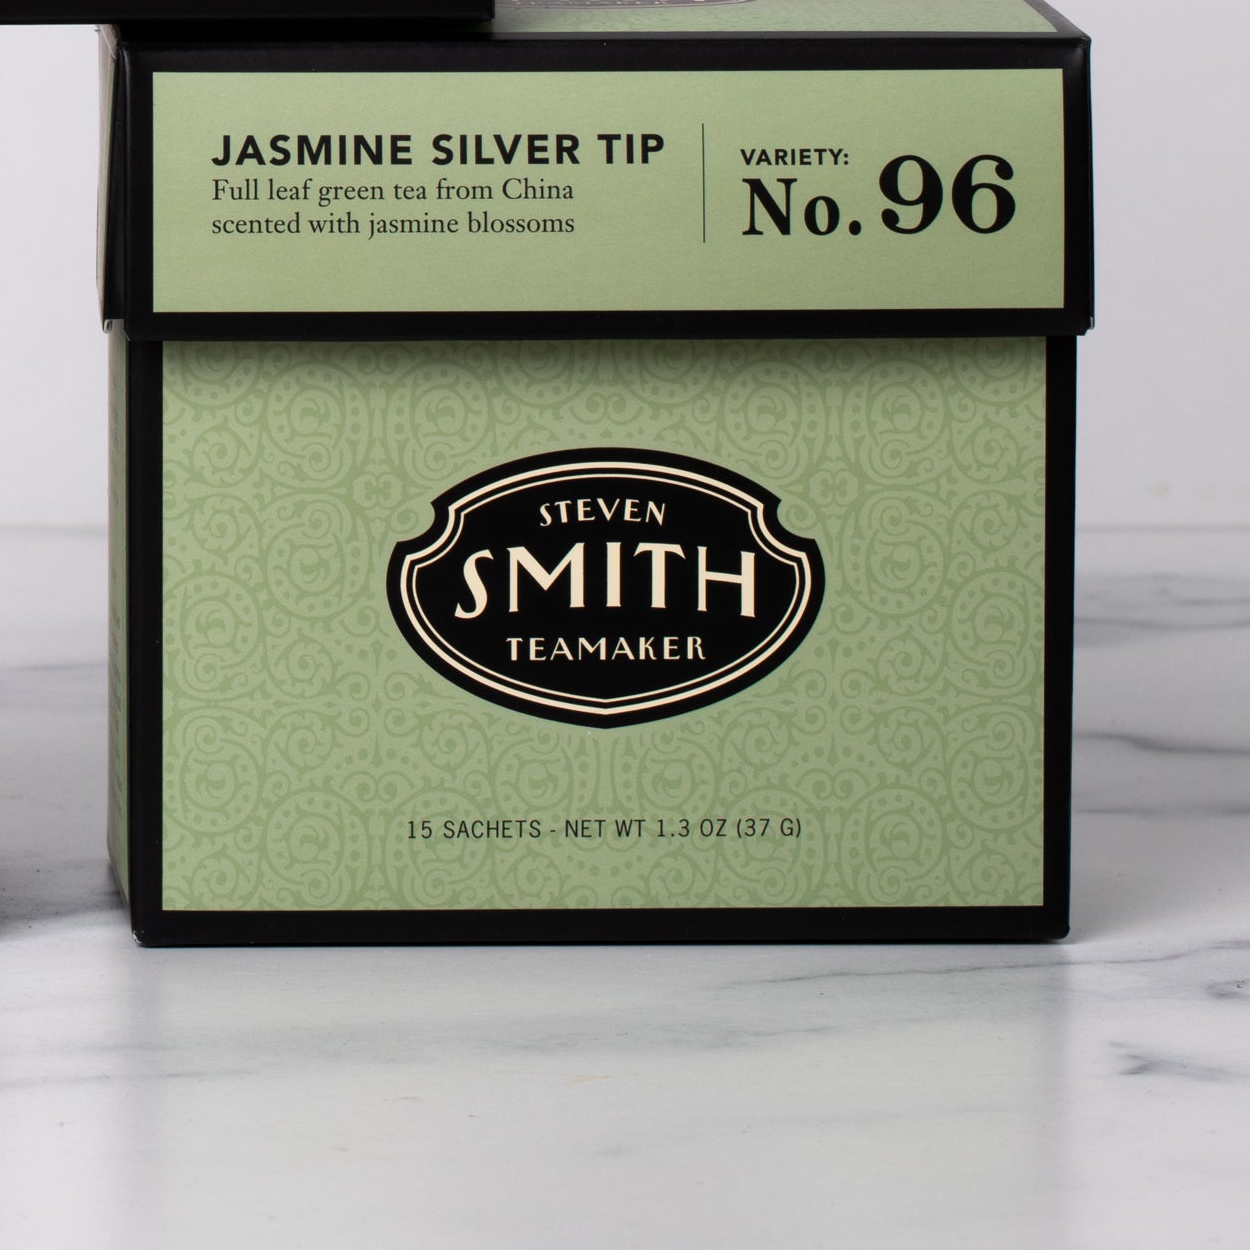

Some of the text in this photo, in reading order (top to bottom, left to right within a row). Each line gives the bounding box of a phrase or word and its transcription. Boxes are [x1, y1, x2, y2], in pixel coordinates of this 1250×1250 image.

[211, 133, 665, 167] JASMINE SILVER TIP
[740, 148, 849, 166] VARIETY:
[212, 177, 574, 208] Full leaf green tea from China
[212, 210, 575, 240] scented with jasmine blossoms
[539, 497, 666, 527] STEVEN
[454, 541, 756, 619] SMITH
[505, 636, 706, 661] TEAMAKER
[408, 820, 433, 840] 15
[443, 819, 541, 839] SACHETS
[565, 819, 607, 838] NET
[614, 819, 646, 838] WT
[657, 818, 690, 838] 1.3
[699, 818, 727, 838] OZ
[736, 818, 771, 839] (37
[780, 817, 802, 839] G)
